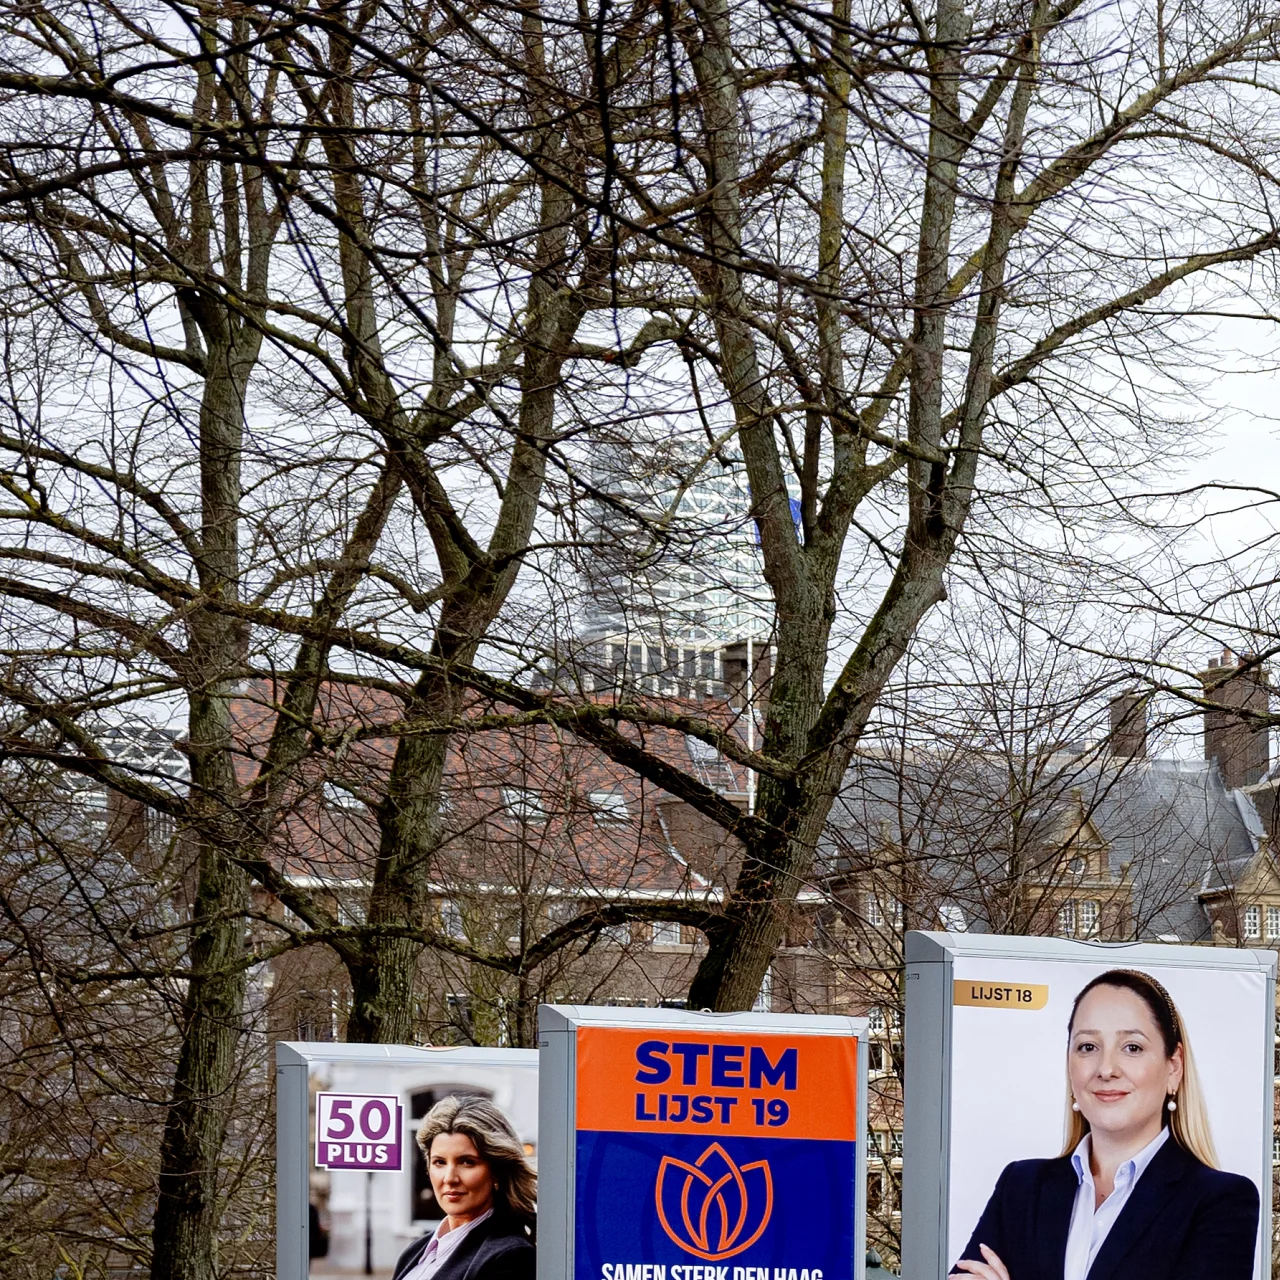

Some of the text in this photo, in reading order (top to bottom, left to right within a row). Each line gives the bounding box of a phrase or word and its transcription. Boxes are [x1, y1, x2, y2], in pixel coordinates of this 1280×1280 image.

[971, 986, 1032, 1002] LIJST 18
[635, 1040, 798, 1090] STEM
[327, 1100, 390, 1140] 50
[636, 1093, 789, 1127] LIJST 19
[328, 1144, 388, 1163] PLUS
